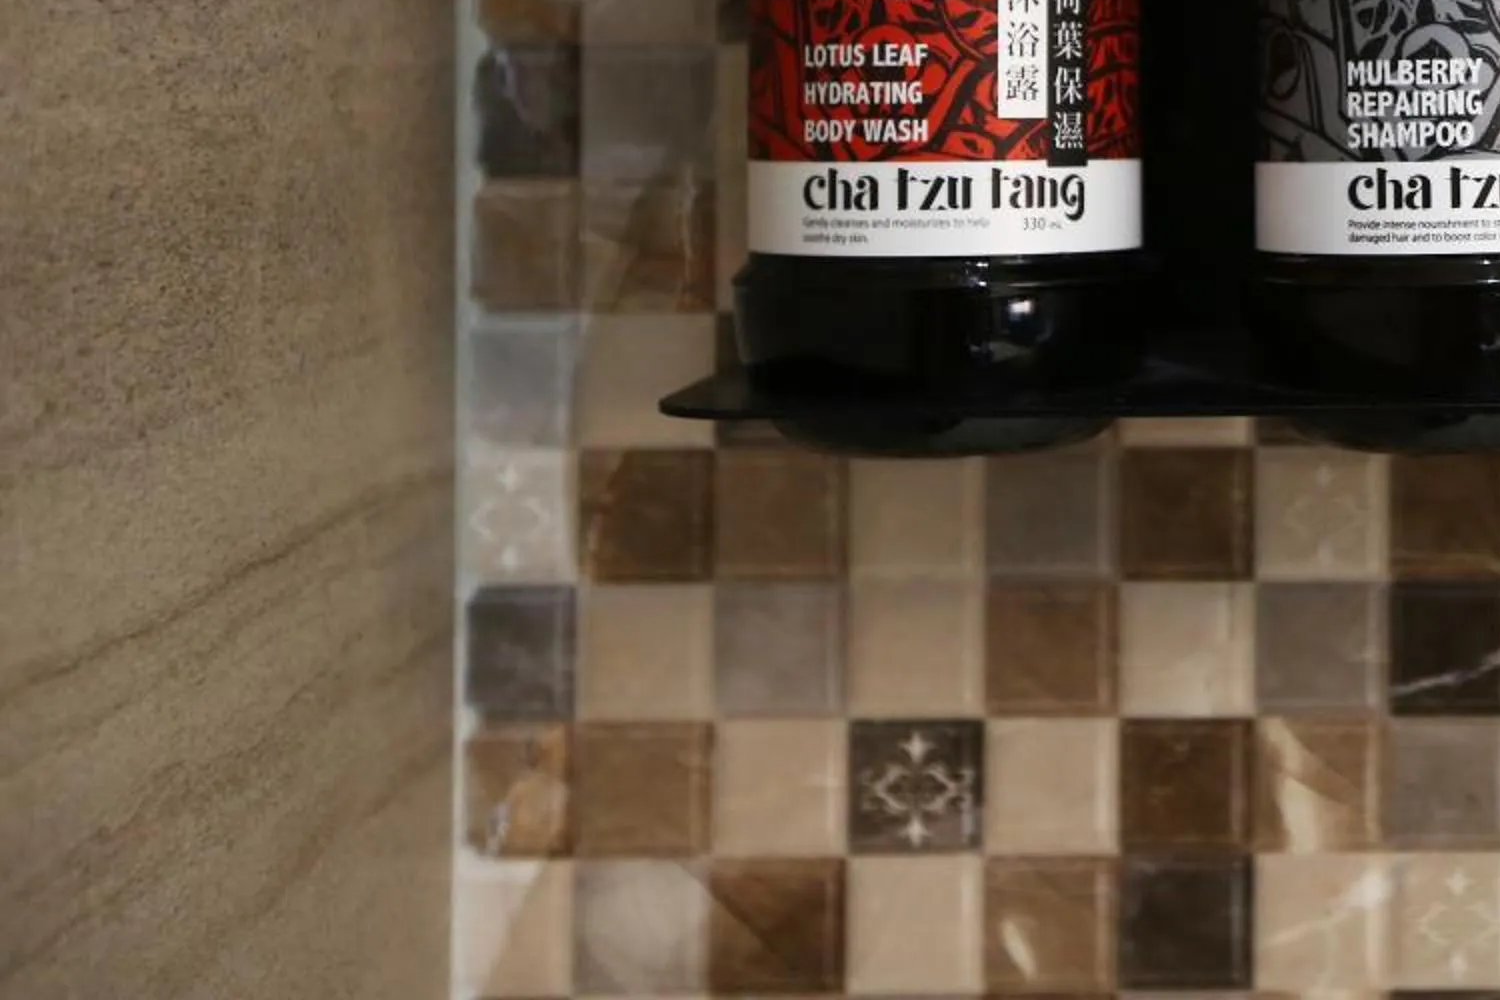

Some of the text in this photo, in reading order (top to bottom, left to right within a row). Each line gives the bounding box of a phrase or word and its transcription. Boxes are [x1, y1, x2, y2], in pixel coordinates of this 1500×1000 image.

[803, 42, 929, 68] LOTUS LEAF
[1346, 58, 1484, 87] MULBERRY
[803, 81, 924, 106] HYDRATING
[1346, 88, 1483, 117] REPAIRING
[803, 118, 929, 143] BODY WASH
[1346, 119, 1475, 149] SHAMPOO
[803, 167, 879, 211] cha
[1348, 167, 1433, 211] cha
[872, 217, 890, 229] and
[1023, 216, 1046, 230] 330
[1348, 218, 1381, 231] Provide
[1348, 231, 1391, 245] damaged
[1392, 231, 1410, 243] hair
[1412, 231, 1431, 243] and
[1432, 231, 1442, 242] to
[1444, 230, 1472, 242] boost
[1474, 230, 1498, 241] color
